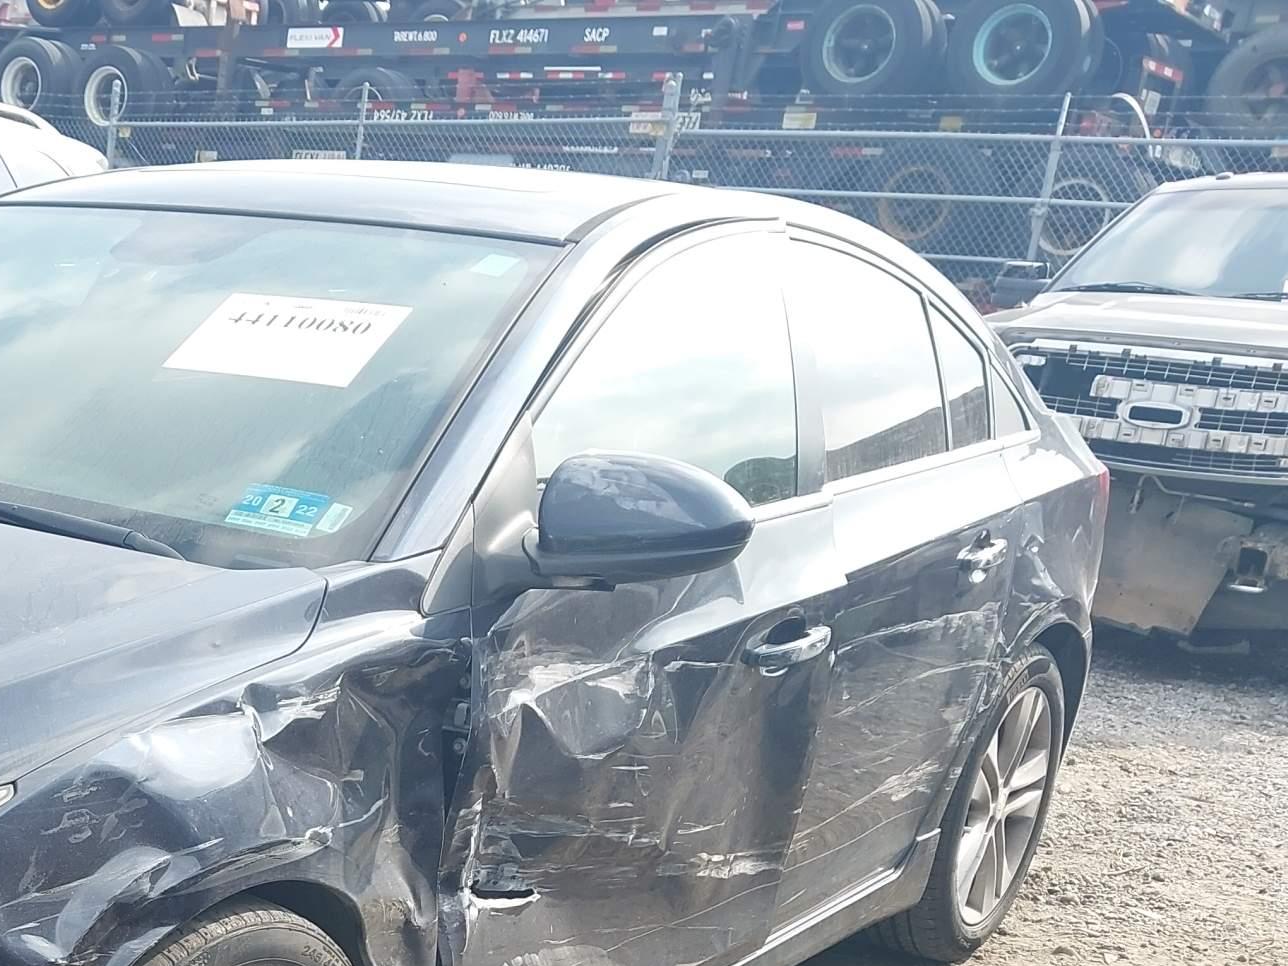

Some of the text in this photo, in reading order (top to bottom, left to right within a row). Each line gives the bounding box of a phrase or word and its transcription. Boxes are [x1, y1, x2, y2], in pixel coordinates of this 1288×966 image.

[489, 28, 549, 44] FLXZ 414671
[583, 27, 610, 43] SACP
[227, 311, 372, 335] 44110080
[242, 494, 318, 517] 20 2 22
